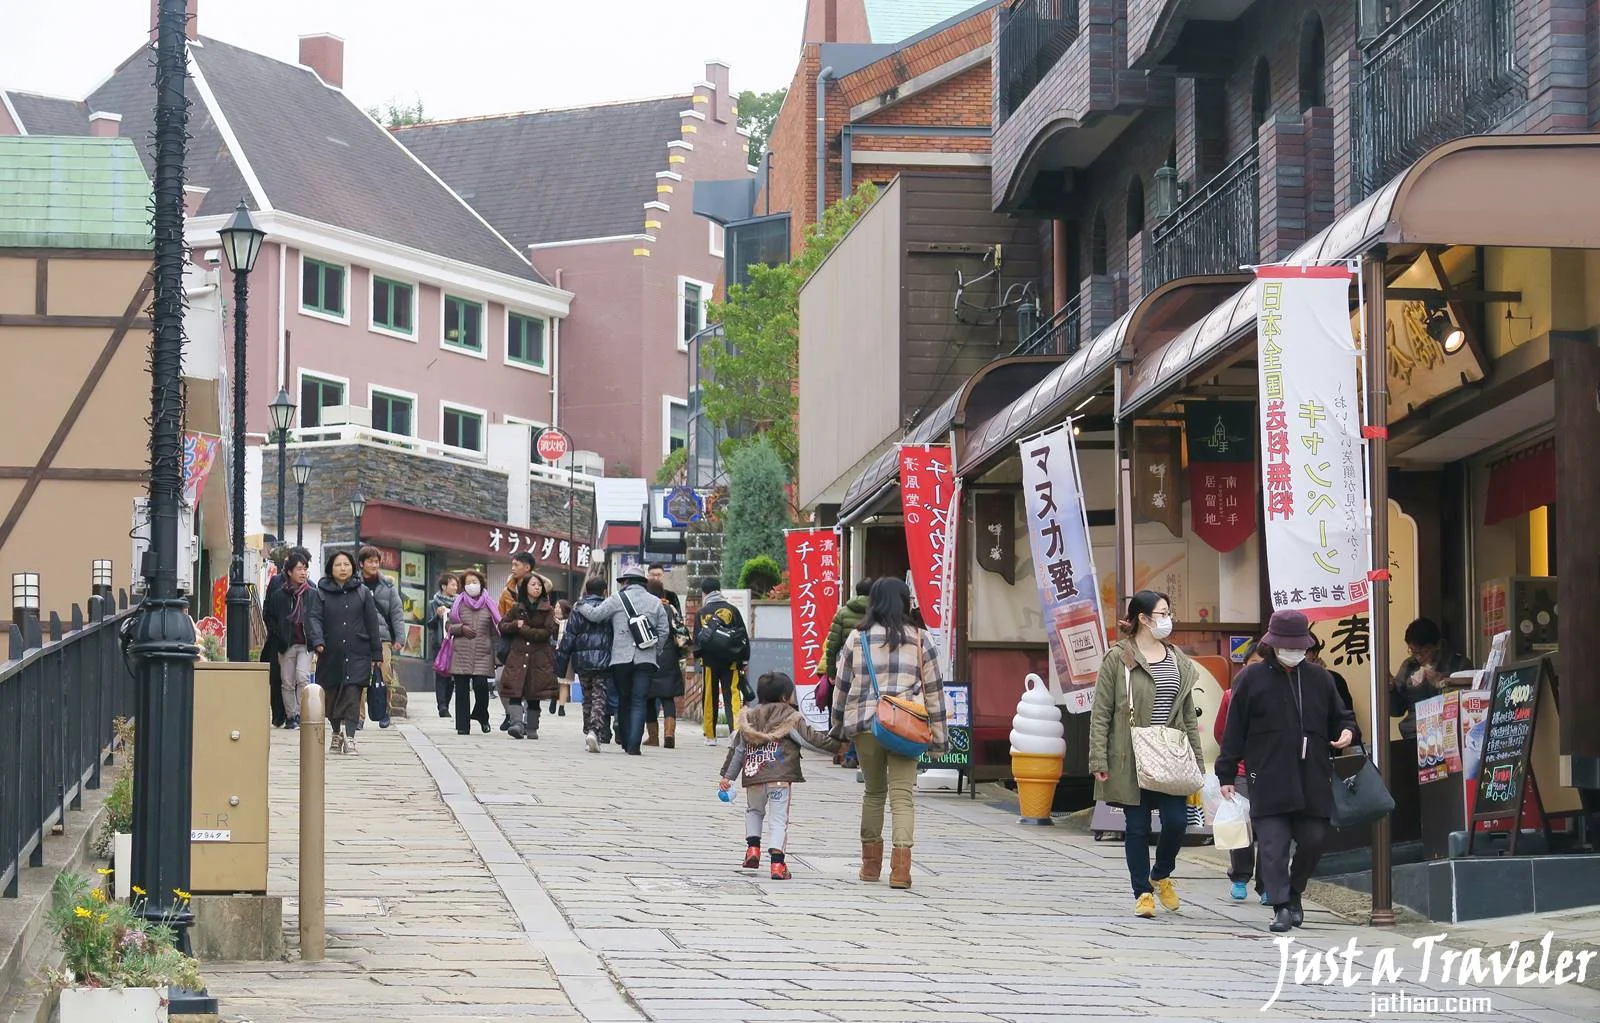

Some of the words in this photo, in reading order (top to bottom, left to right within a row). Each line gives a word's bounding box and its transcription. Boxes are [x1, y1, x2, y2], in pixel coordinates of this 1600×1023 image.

[541, 440, 565, 452] 消火栓
[1030, 445, 1079, 602] マヌカ蜜
[1204, 475, 1221, 526] 居留地
[1221, 475, 1239, 526] 南山手
[819, 539, 836, 598] 清風堂の
[795, 540, 820, 679] チーズカステラ
